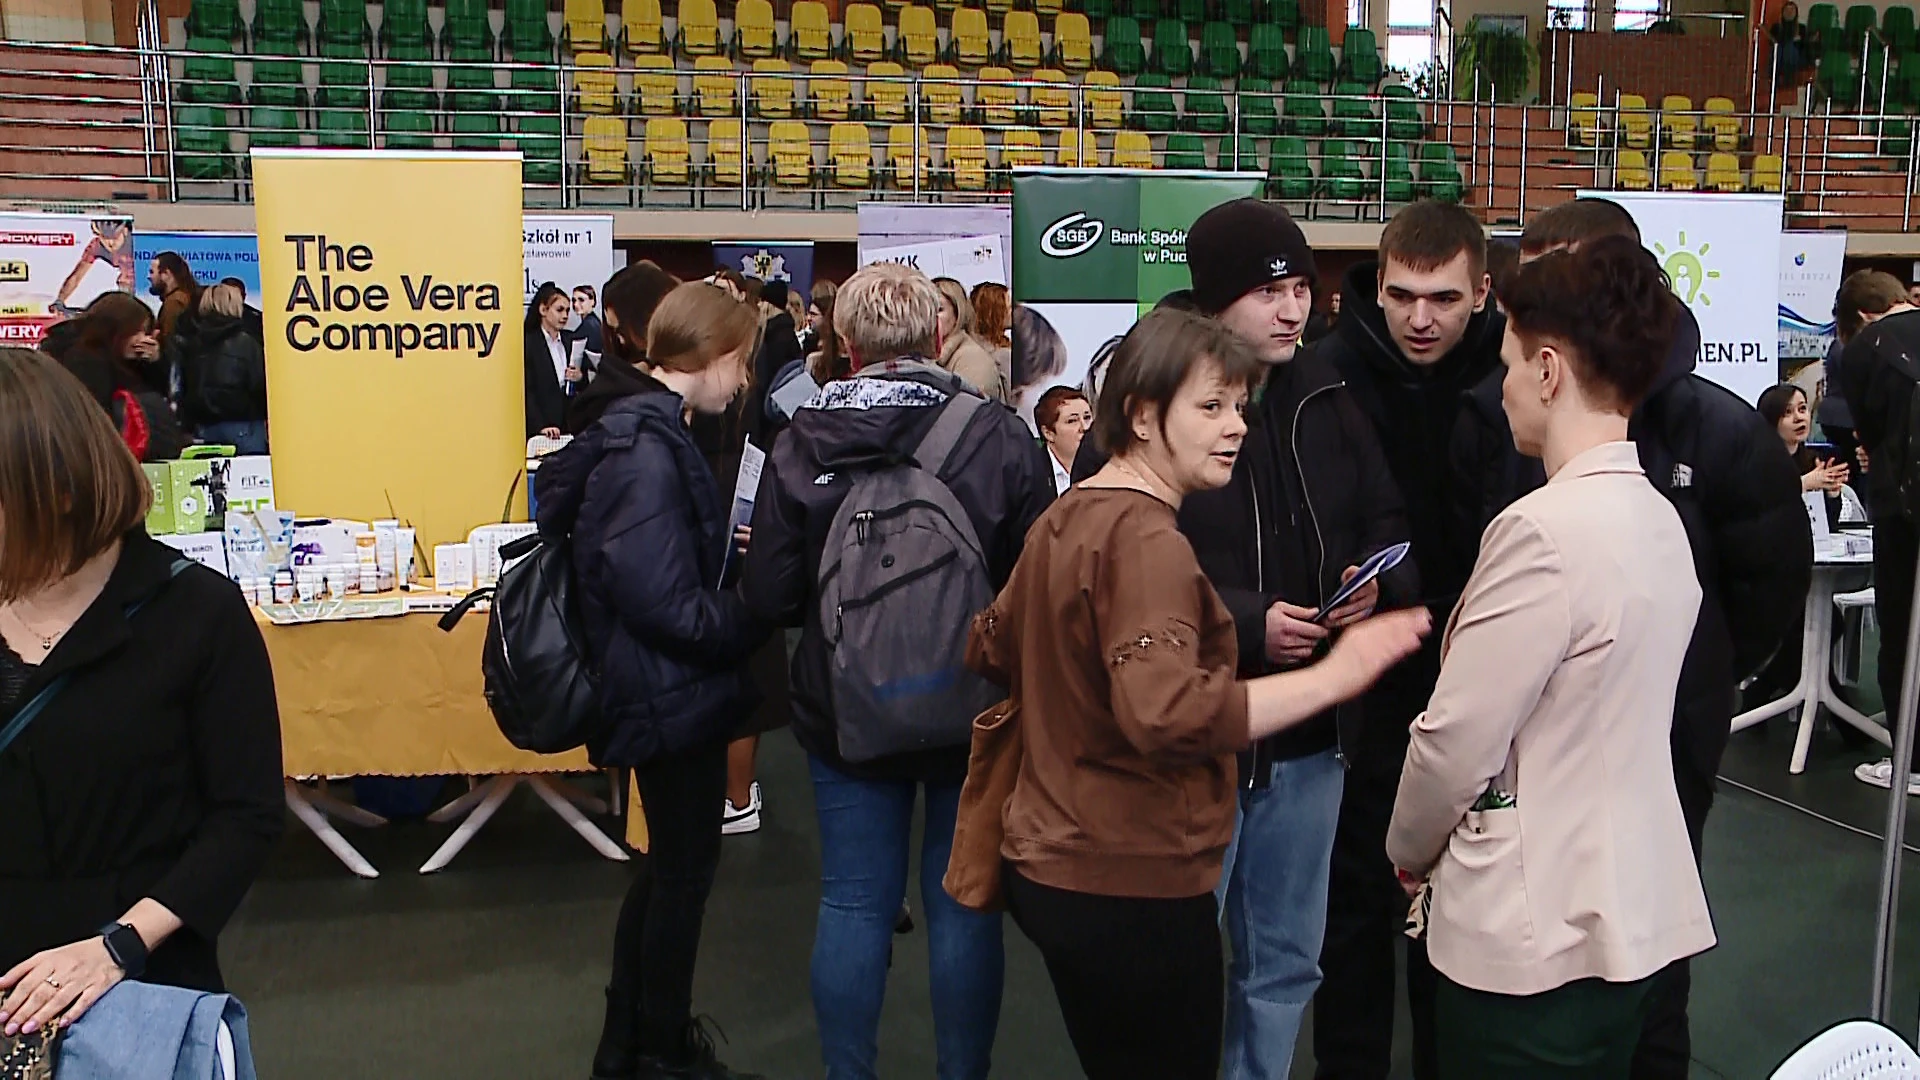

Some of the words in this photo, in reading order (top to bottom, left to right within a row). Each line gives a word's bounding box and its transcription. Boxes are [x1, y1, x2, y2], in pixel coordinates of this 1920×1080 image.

[564, 232, 580, 244] nr
[585, 230, 593, 244] 1
[1056, 229, 1088, 243] SGB
[1110, 228, 1147, 244] Bank
[285, 235, 373, 272] The
[1144, 252, 1156, 262] w
[285, 275, 390, 312] Aloe
[400, 275, 500, 311] Vera
[286, 314, 501, 358] Company
[1699, 343, 1768, 362] EN.PL
